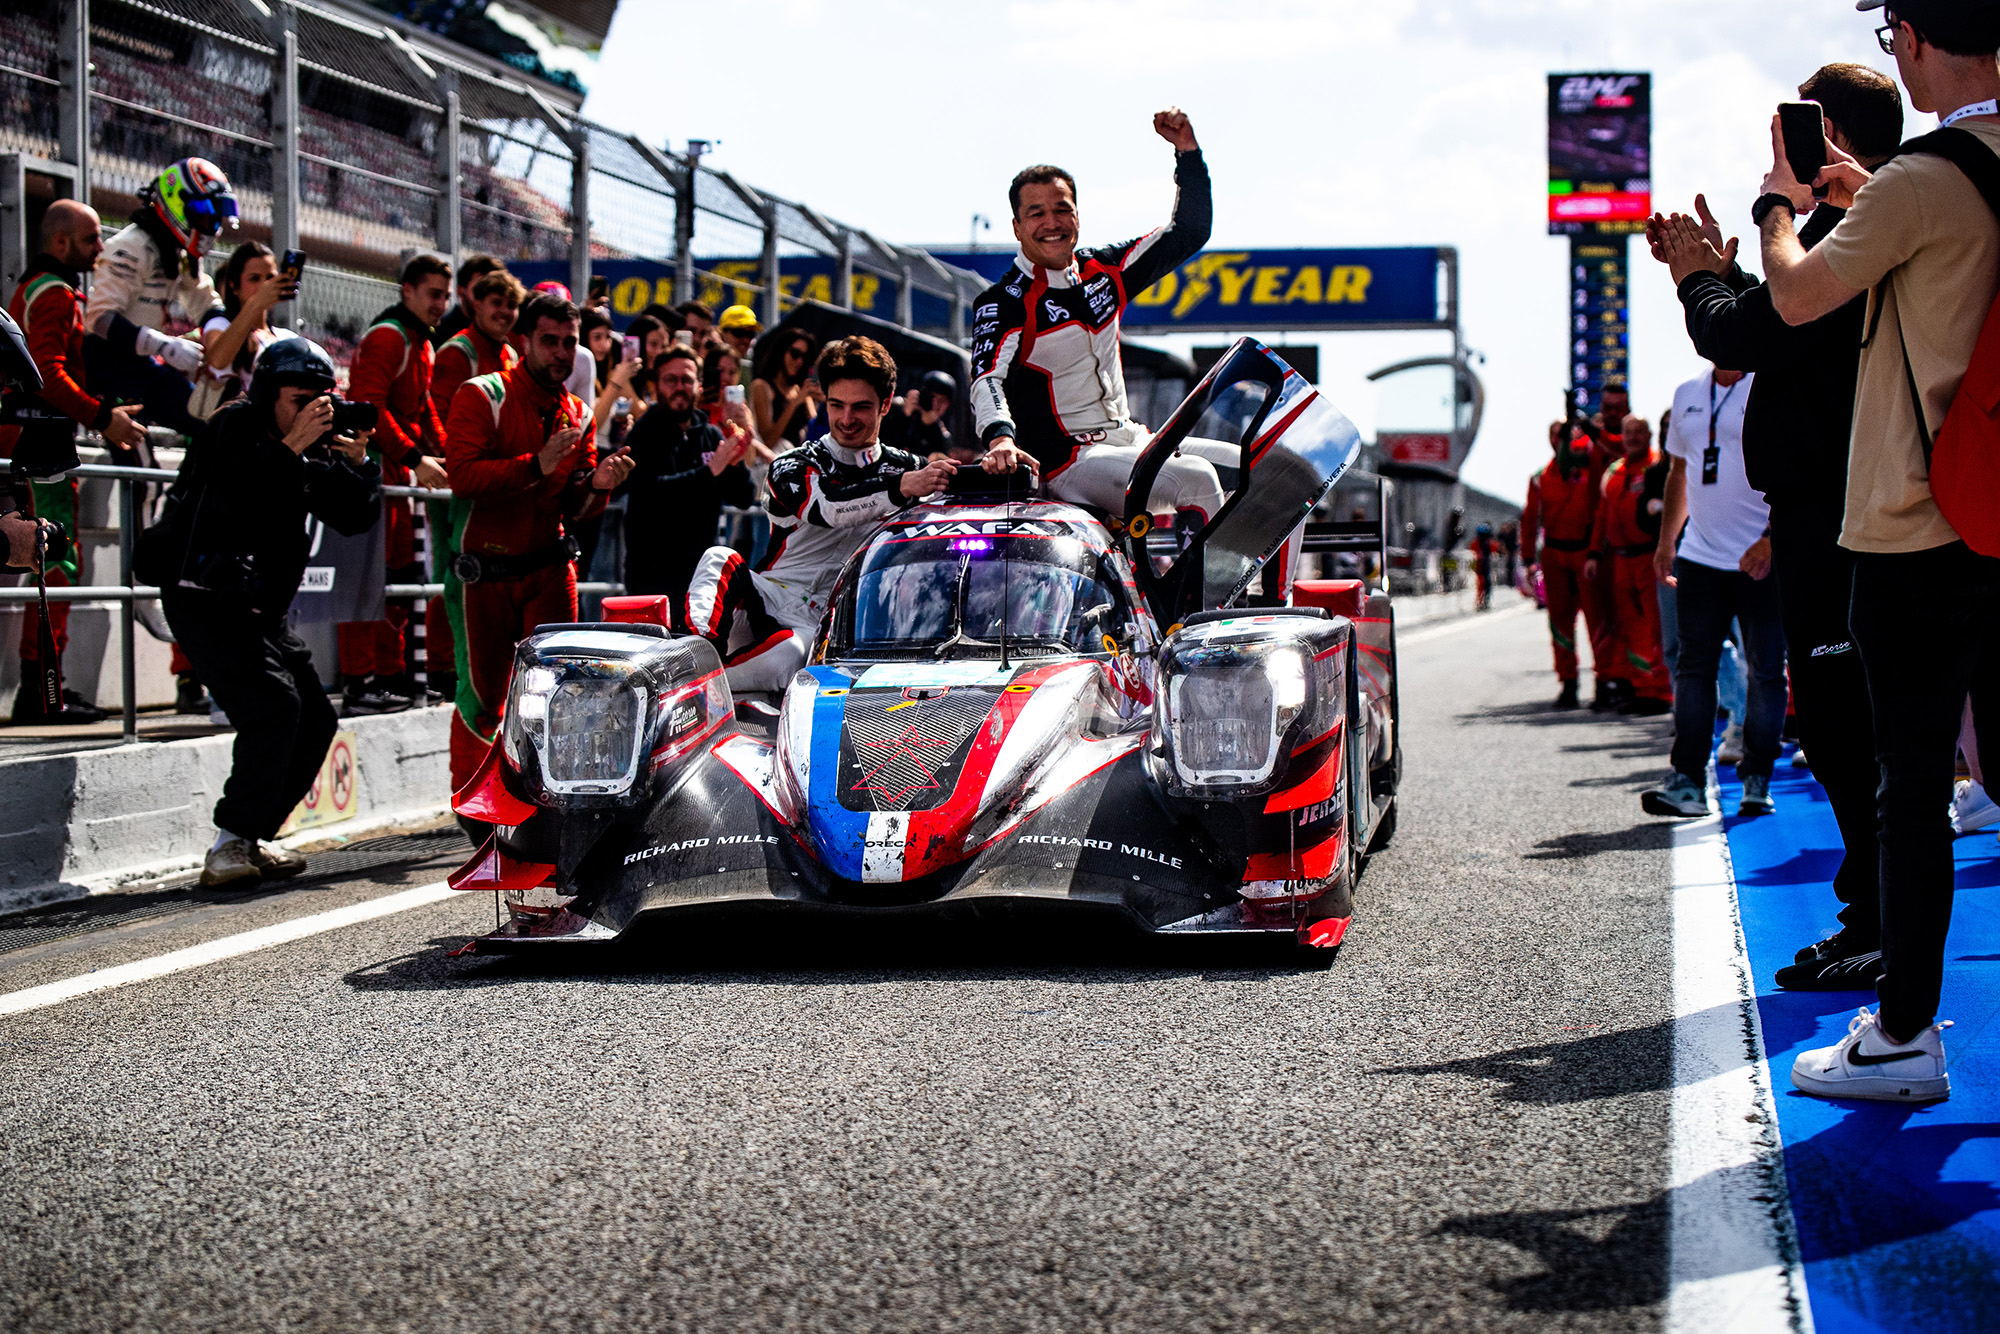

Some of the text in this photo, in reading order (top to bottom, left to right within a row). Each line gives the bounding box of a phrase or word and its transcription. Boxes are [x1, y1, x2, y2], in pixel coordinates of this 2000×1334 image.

[904, 521, 1051, 539] WAFA
[47, 668, 57, 704] Canon
[623, 834, 779, 865] RICHARD MILLE
[864, 840, 915, 848] ORECA
[1018, 835, 1183, 869] RICHARD MILLE
